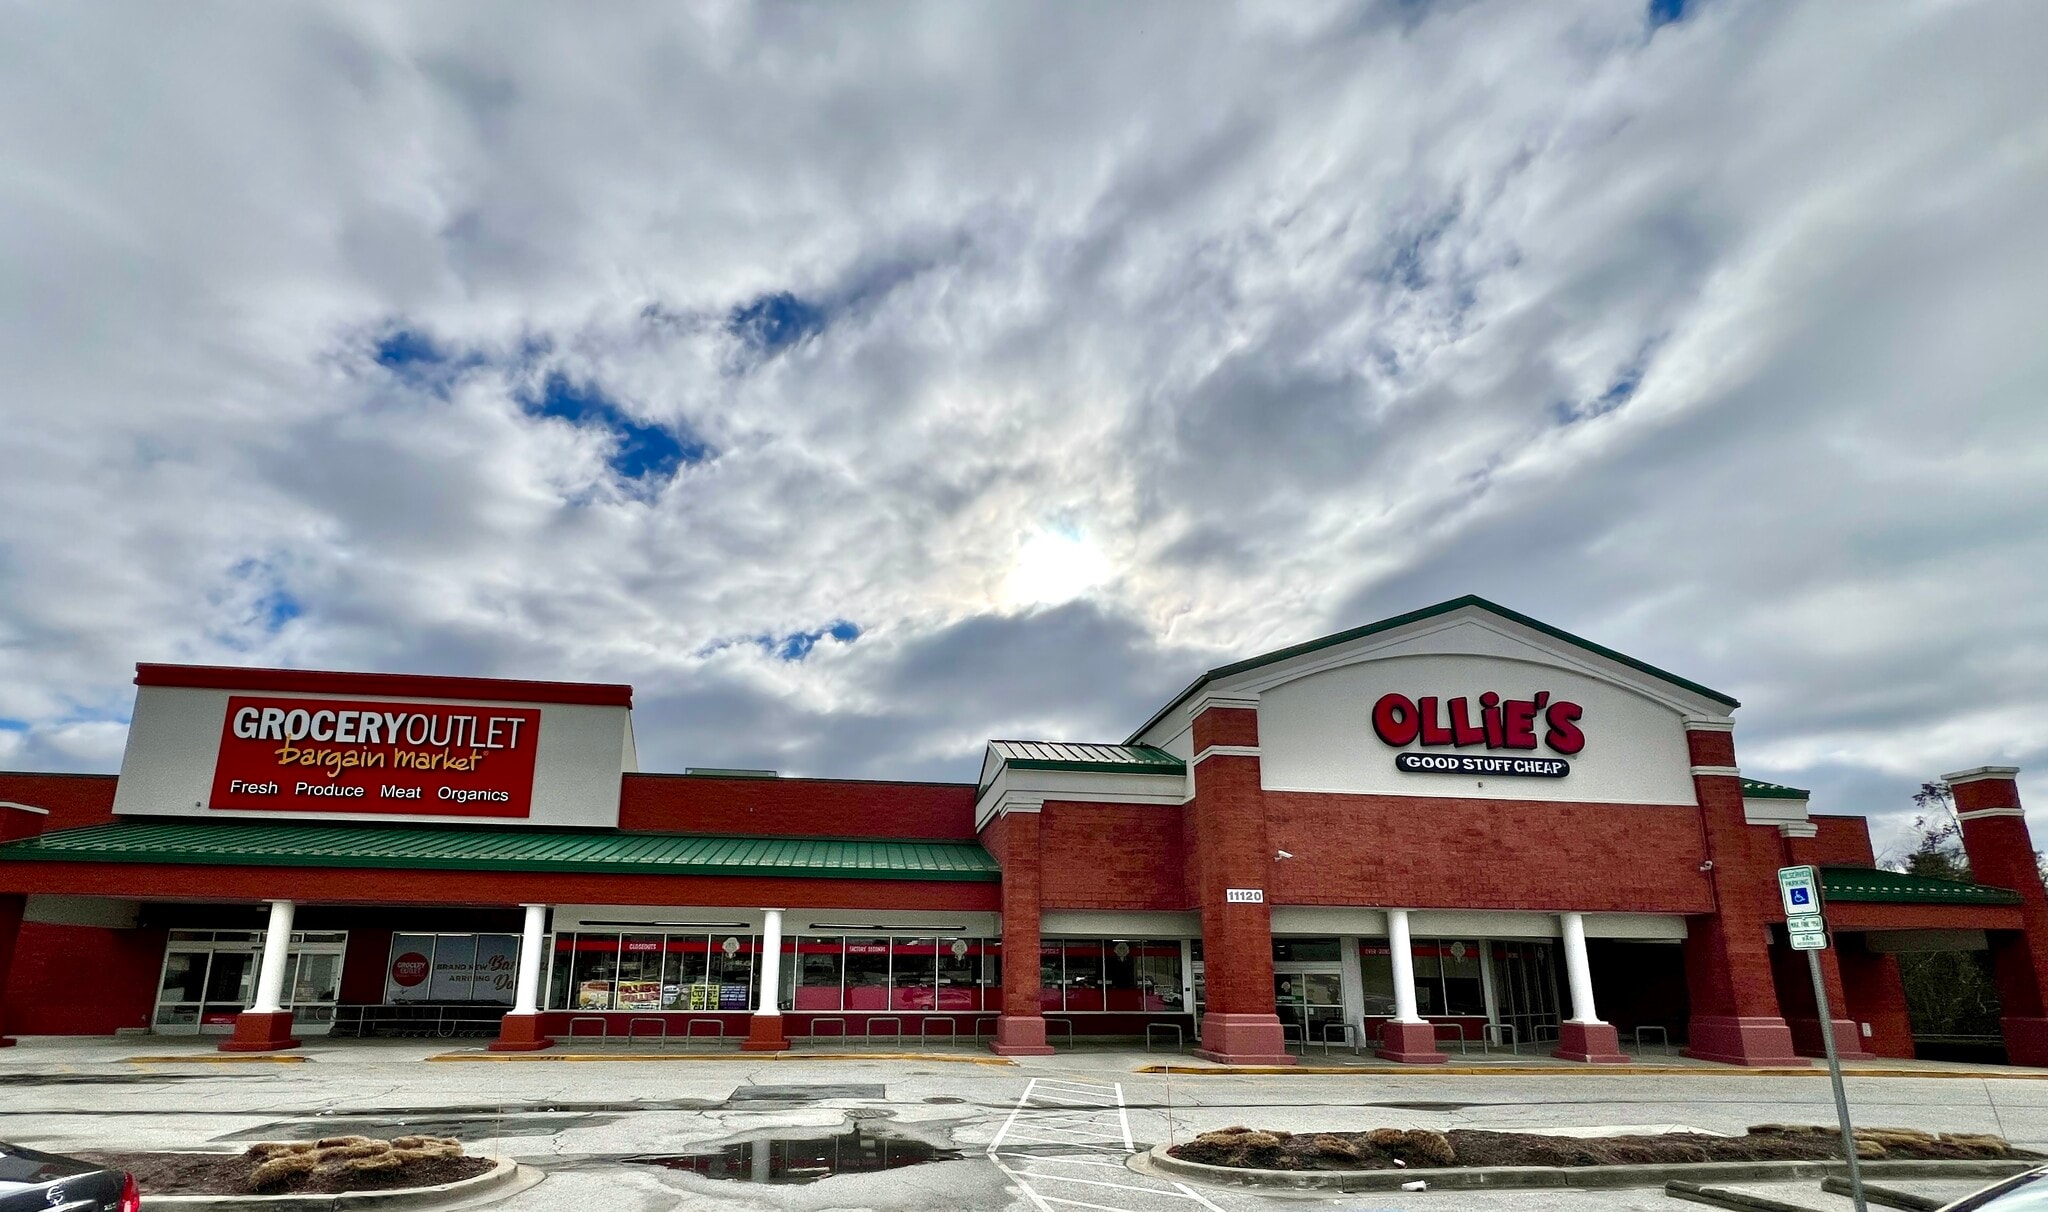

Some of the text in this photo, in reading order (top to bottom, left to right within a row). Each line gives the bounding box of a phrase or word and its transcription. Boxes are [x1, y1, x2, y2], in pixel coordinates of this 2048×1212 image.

[275, 734, 384, 777] bargain
[1463, 759, 1513, 771] STUFF
[230, 780, 509, 801] Fresh Produce Meat Organics
[1229, 891, 1261, 901] 11120
[436, 963, 467, 971] BRAND
[468, 963, 489, 971] NEW
